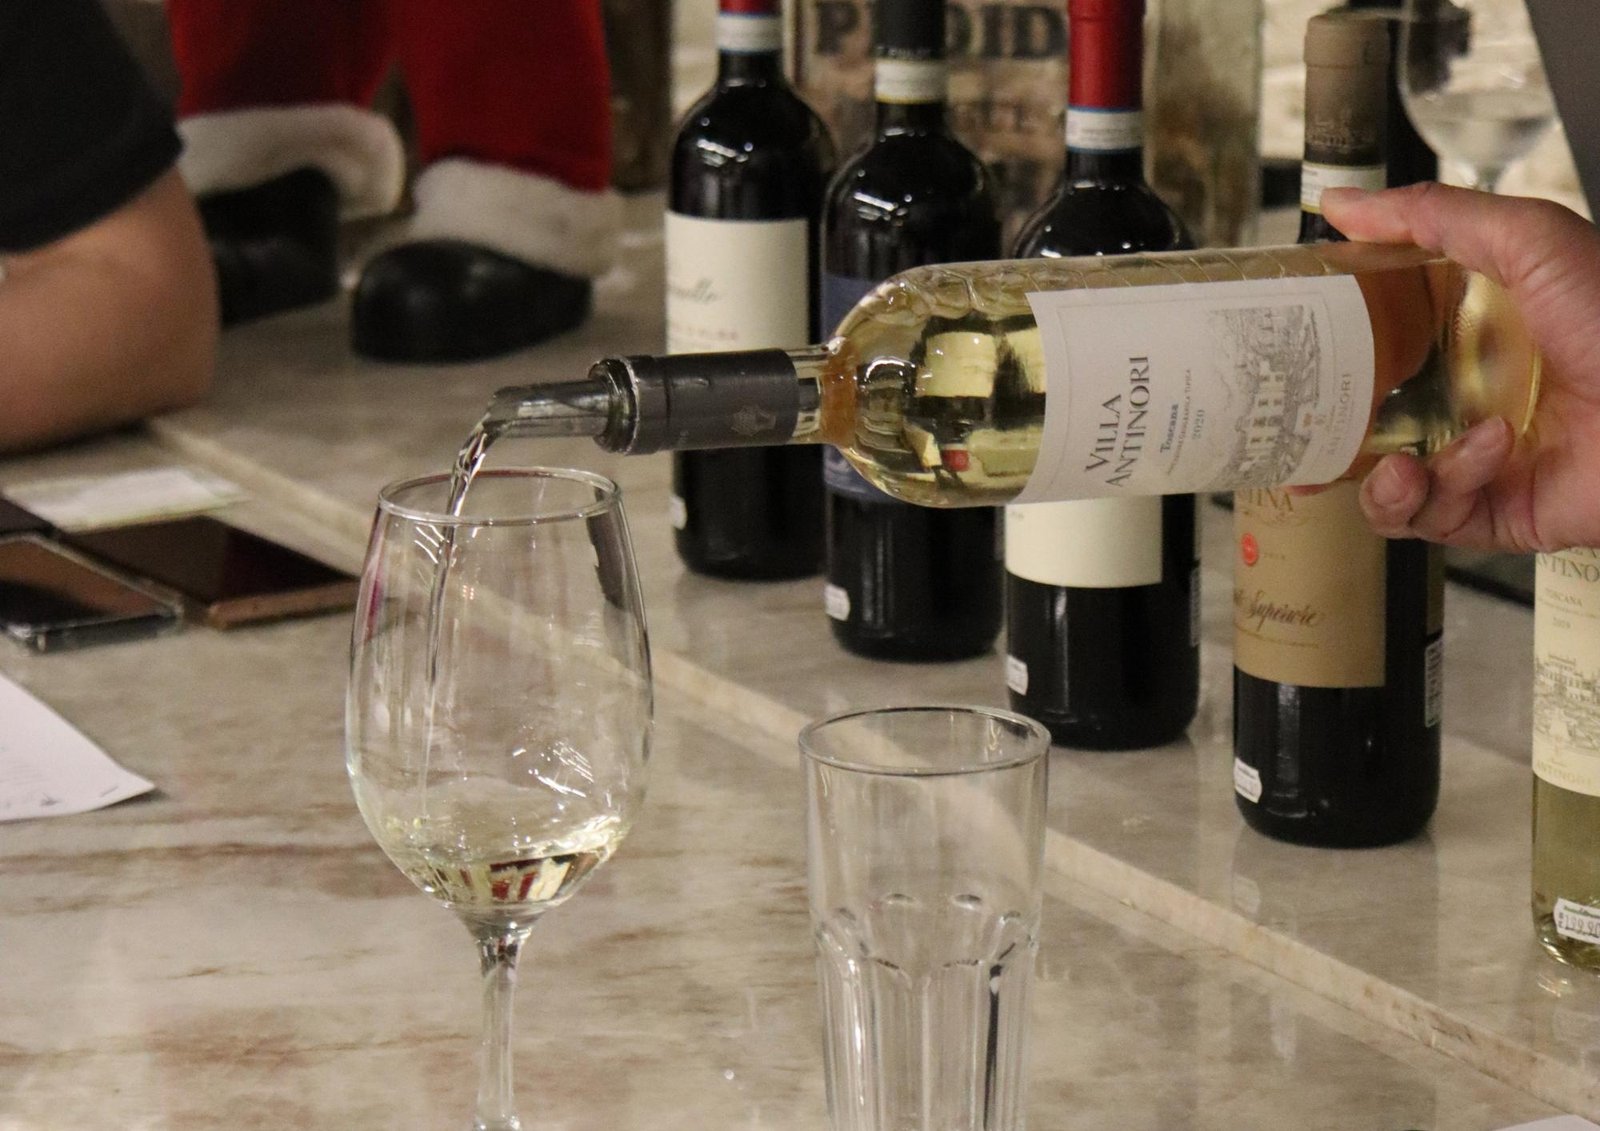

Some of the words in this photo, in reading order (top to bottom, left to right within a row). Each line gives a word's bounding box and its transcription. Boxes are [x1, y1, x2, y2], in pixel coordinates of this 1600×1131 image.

[1084, 394, 1122, 471] VILLA
[1105, 356, 1150, 487] ANTINORI
[1160, 404, 1179, 453] Toscana
